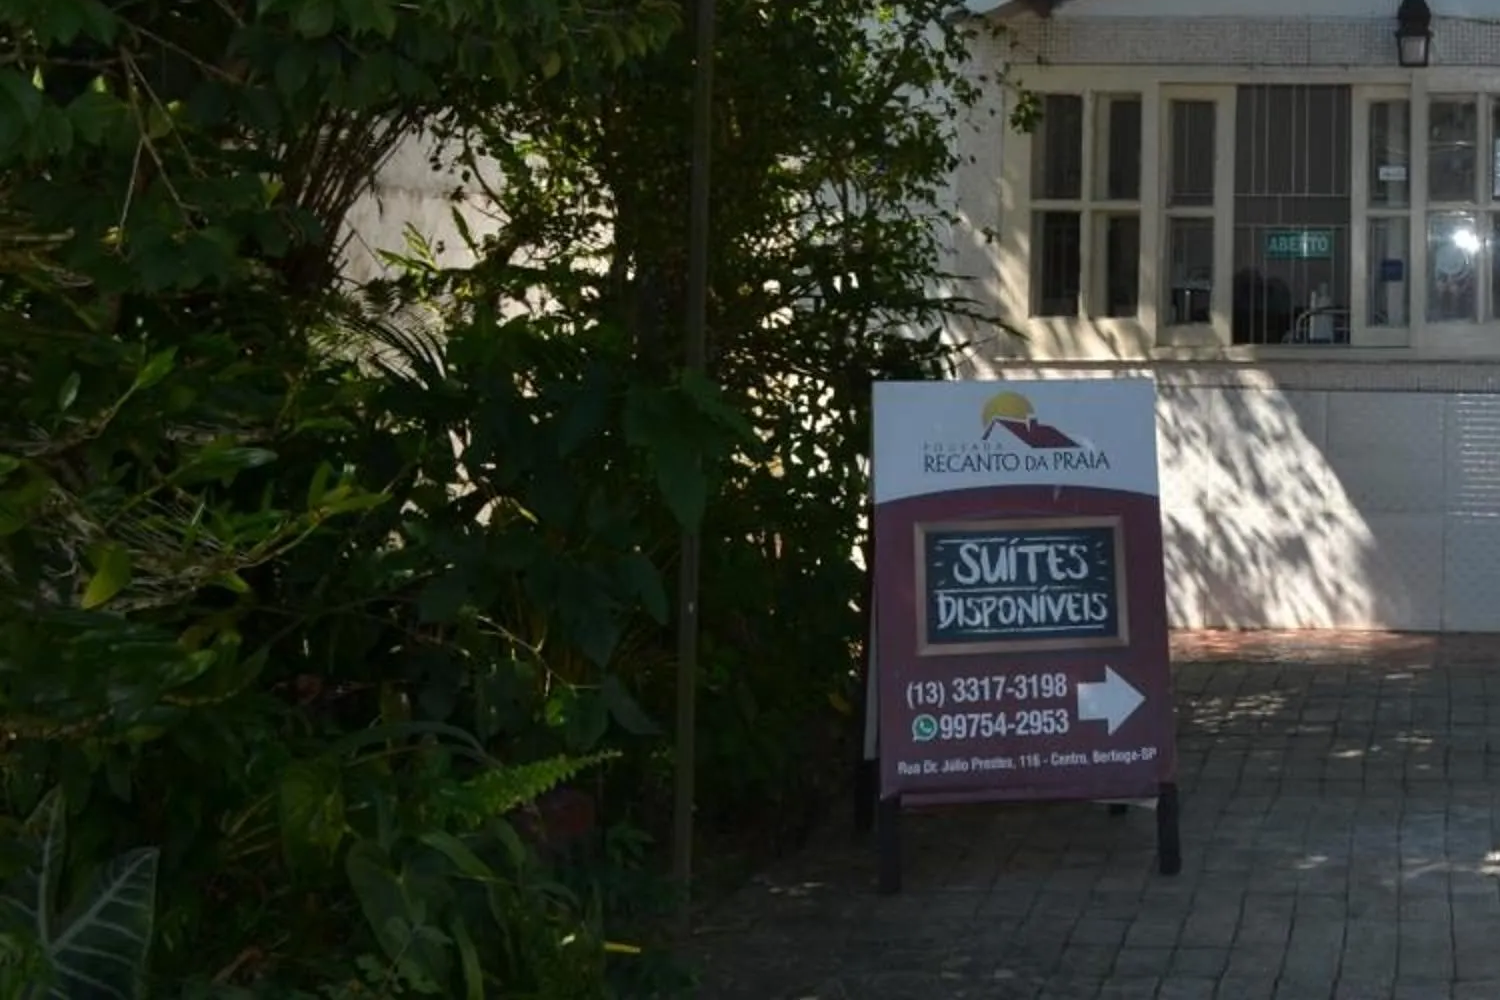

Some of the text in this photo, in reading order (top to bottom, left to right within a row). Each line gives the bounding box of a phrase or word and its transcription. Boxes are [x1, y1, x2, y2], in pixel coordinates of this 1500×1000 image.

[1269, 234, 1328, 253] ABERTO
[924, 450, 1111, 473] RECANTO DA PRAIA
[953, 537, 1089, 585] SUÍTES
[936, 585, 1108, 630] DISPONÍVEIS
[906, 672, 1068, 708] (13) 3317-3198
[940, 708, 1070, 740] 99754-2953
